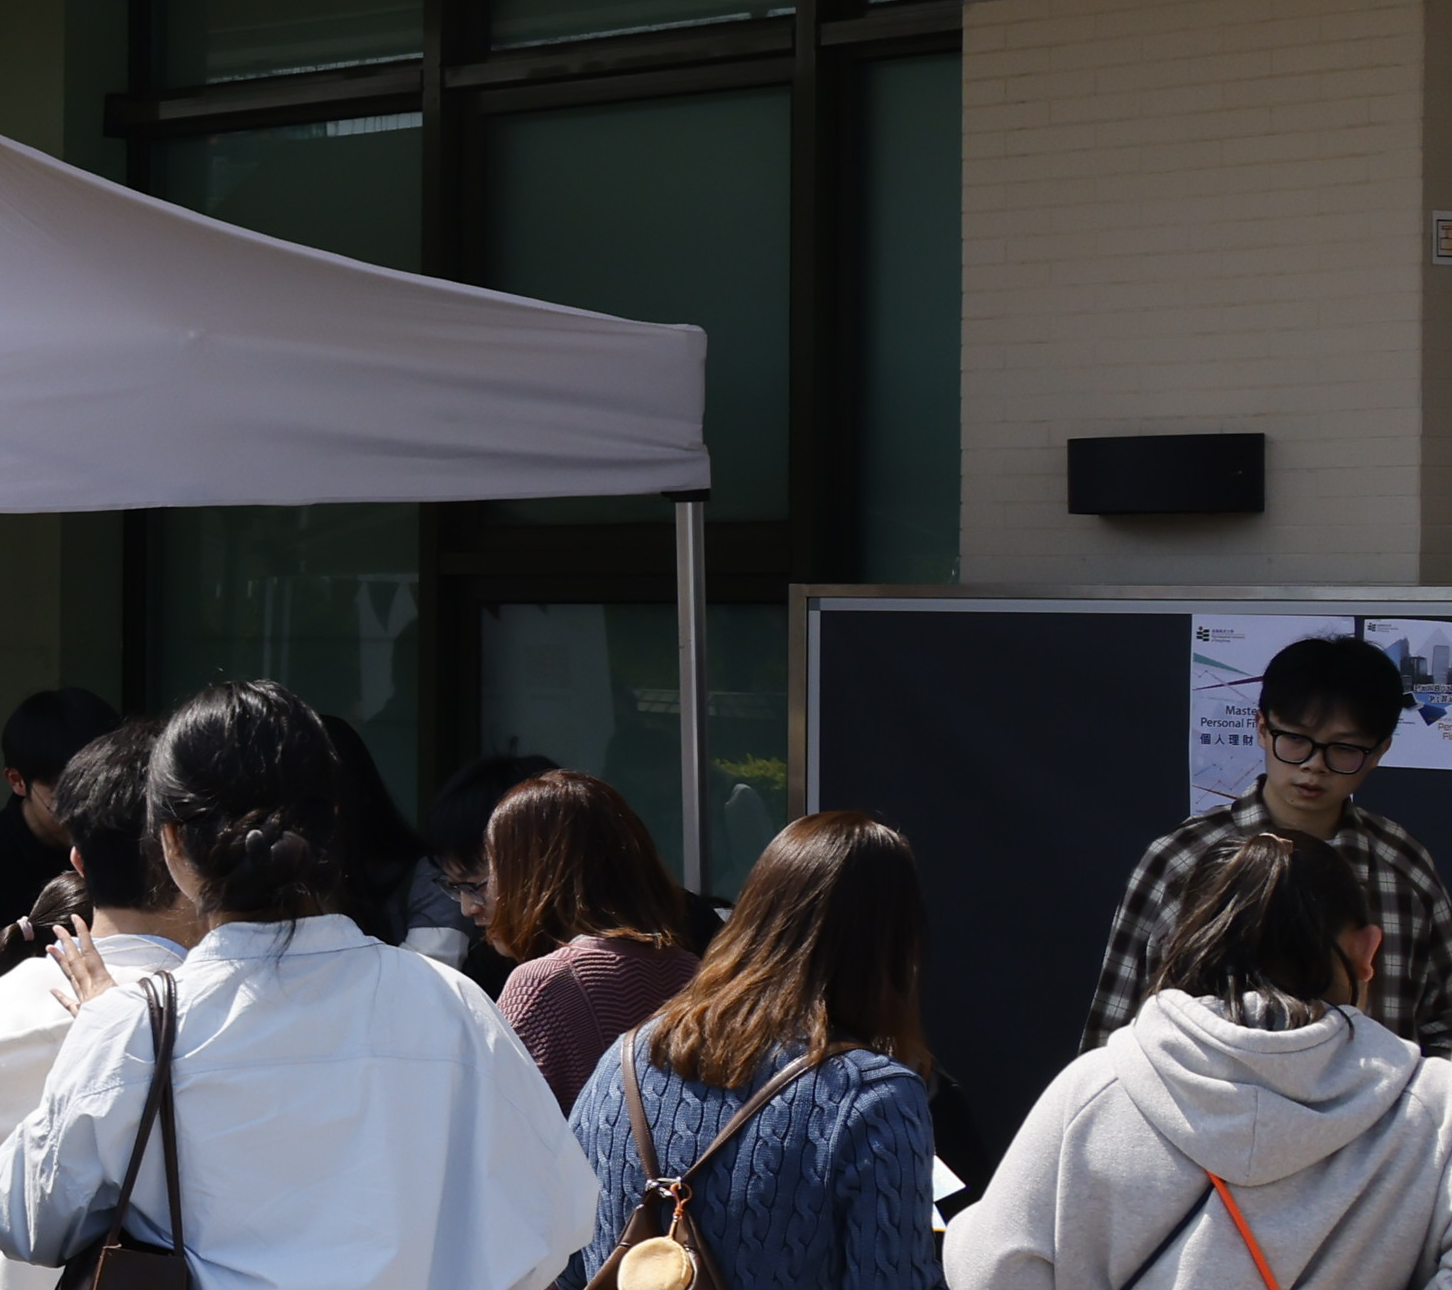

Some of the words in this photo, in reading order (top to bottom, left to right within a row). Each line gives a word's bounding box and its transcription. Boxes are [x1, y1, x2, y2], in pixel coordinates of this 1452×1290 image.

[1225, 705, 1257, 716] Maste
[1200, 717, 1244, 728] Personal
[1200, 733, 1254, 747] 個人理財
